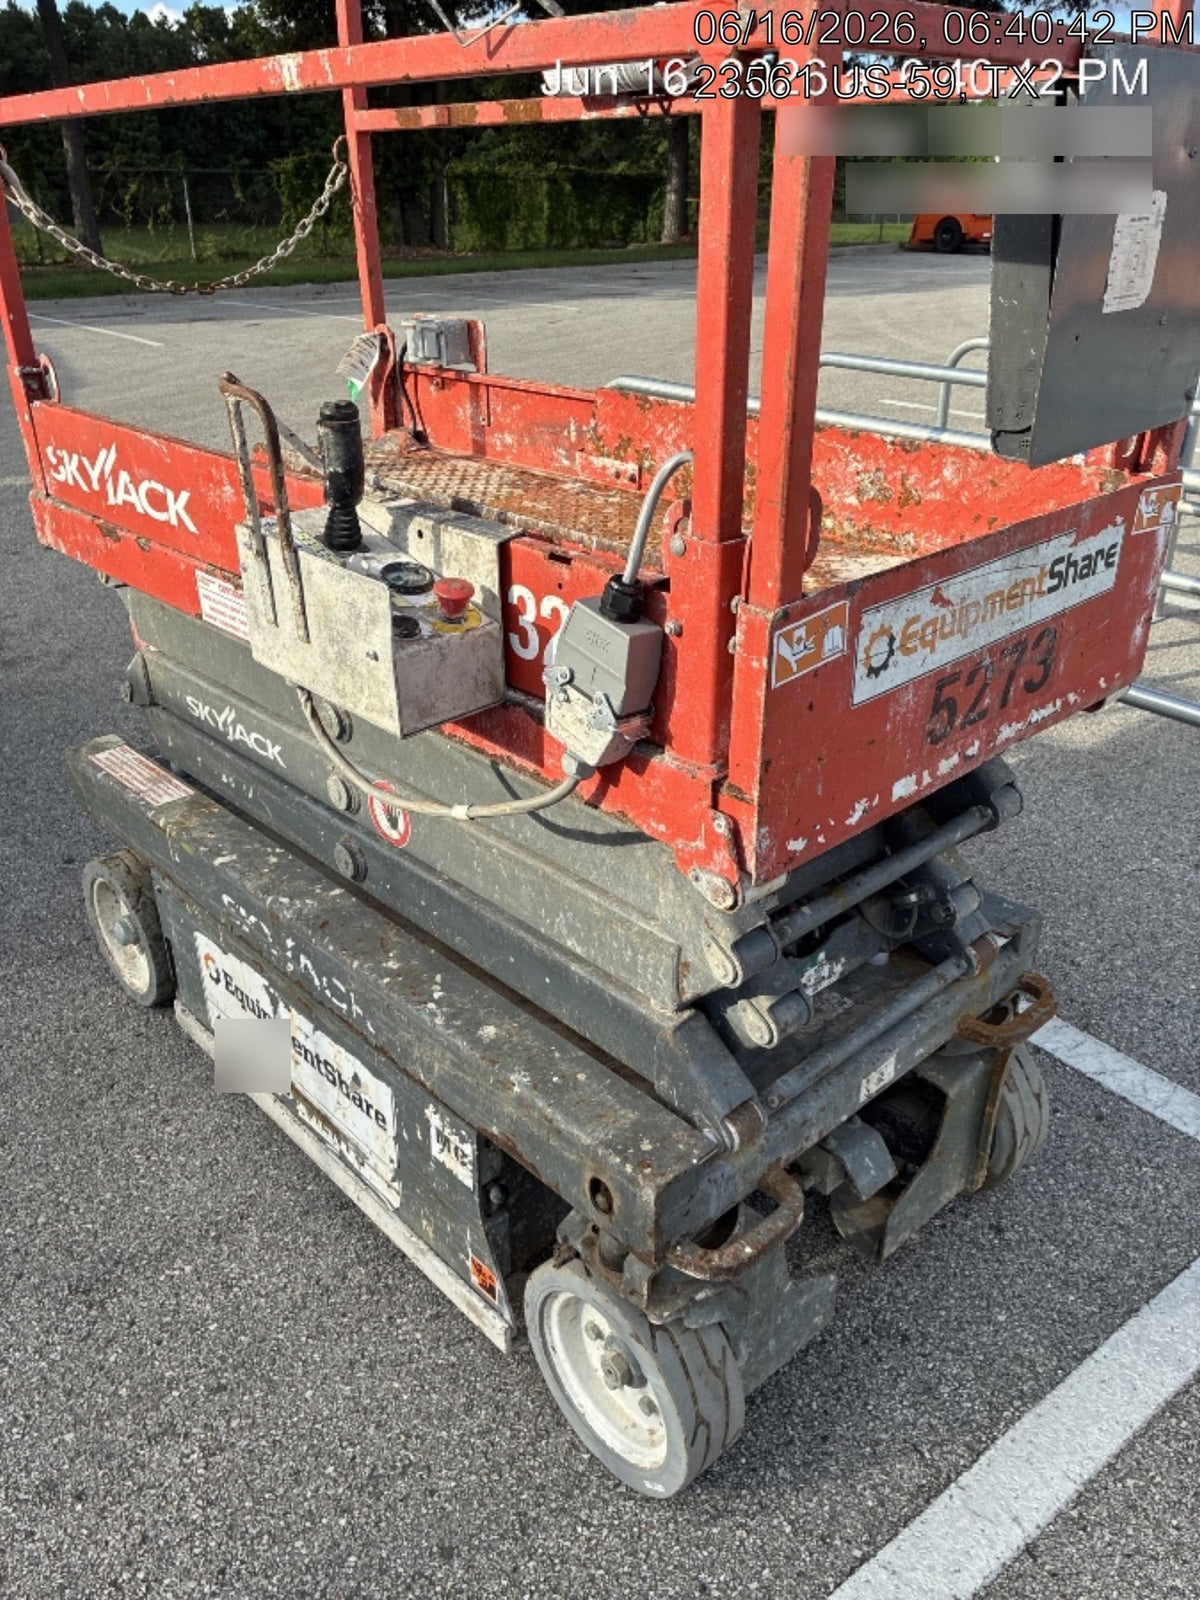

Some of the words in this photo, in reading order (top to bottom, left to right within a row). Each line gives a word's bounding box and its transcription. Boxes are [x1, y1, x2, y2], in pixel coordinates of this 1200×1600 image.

[46, 441, 199, 534] SKYJACK
[899, 541, 1119, 656] EquipmentShare
[185, 694, 286, 768] SKYJACK
[926, 626, 1057, 745] 5273
